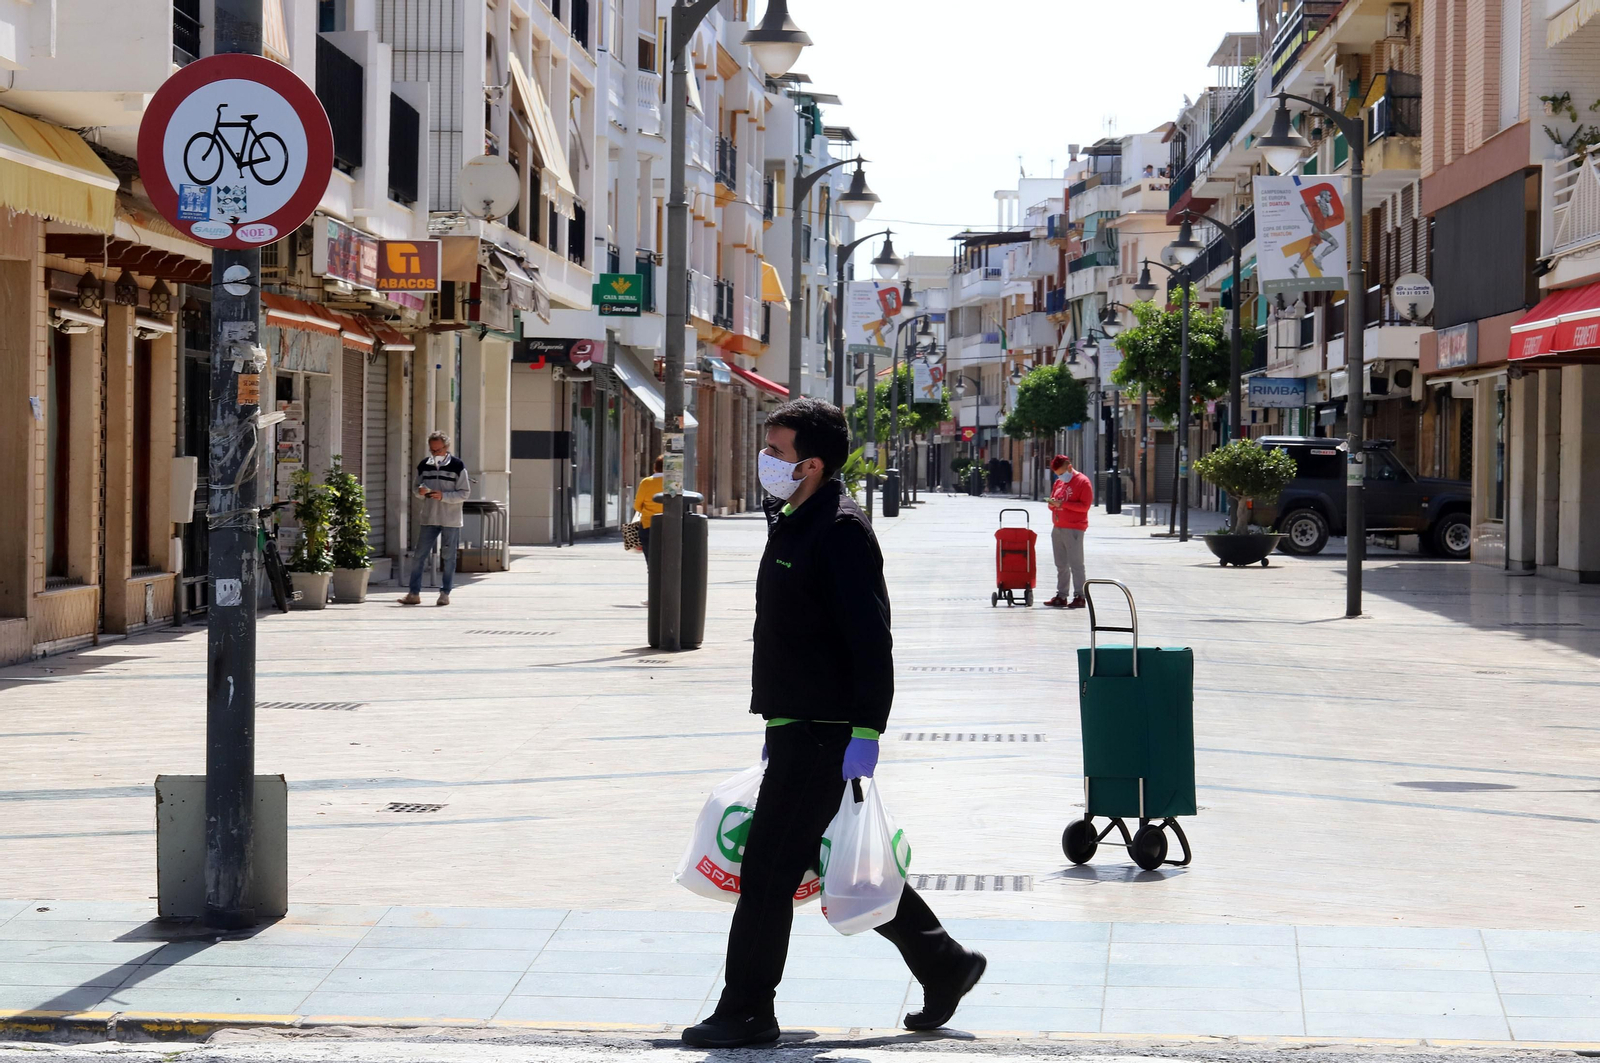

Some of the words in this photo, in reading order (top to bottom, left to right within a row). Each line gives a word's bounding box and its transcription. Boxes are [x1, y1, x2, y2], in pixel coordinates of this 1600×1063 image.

[240, 228, 265, 238] NOE
[377, 278, 435, 289] ABACOS
[1573, 324, 1599, 346] FERRETTI
[1522, 335, 1543, 356] FERRETTI
[700, 860, 741, 890] SPA
[796, 880, 820, 897] SP
